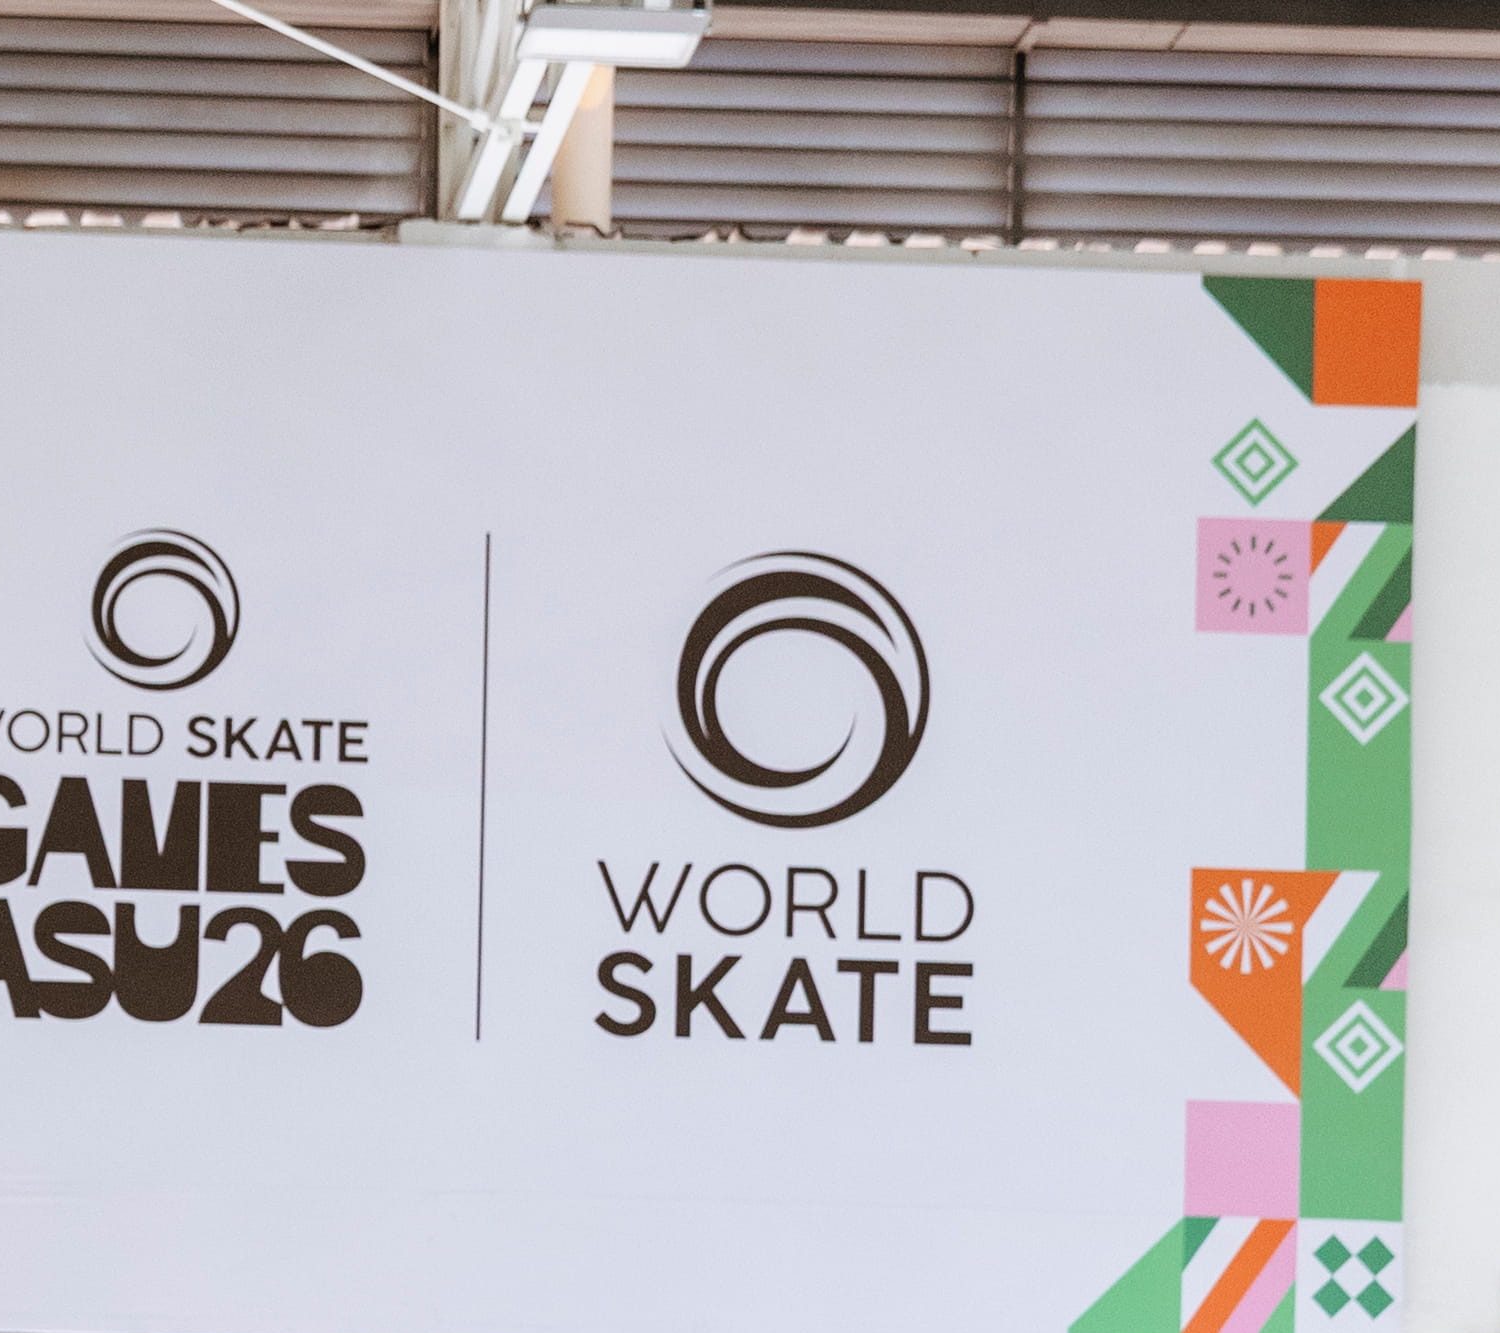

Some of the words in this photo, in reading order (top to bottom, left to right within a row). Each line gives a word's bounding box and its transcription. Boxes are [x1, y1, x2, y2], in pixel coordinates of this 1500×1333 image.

[186, 715, 369, 764] SKATE
[597, 860, 975, 942] WORLD
[595, 951, 974, 1046] SKATE
